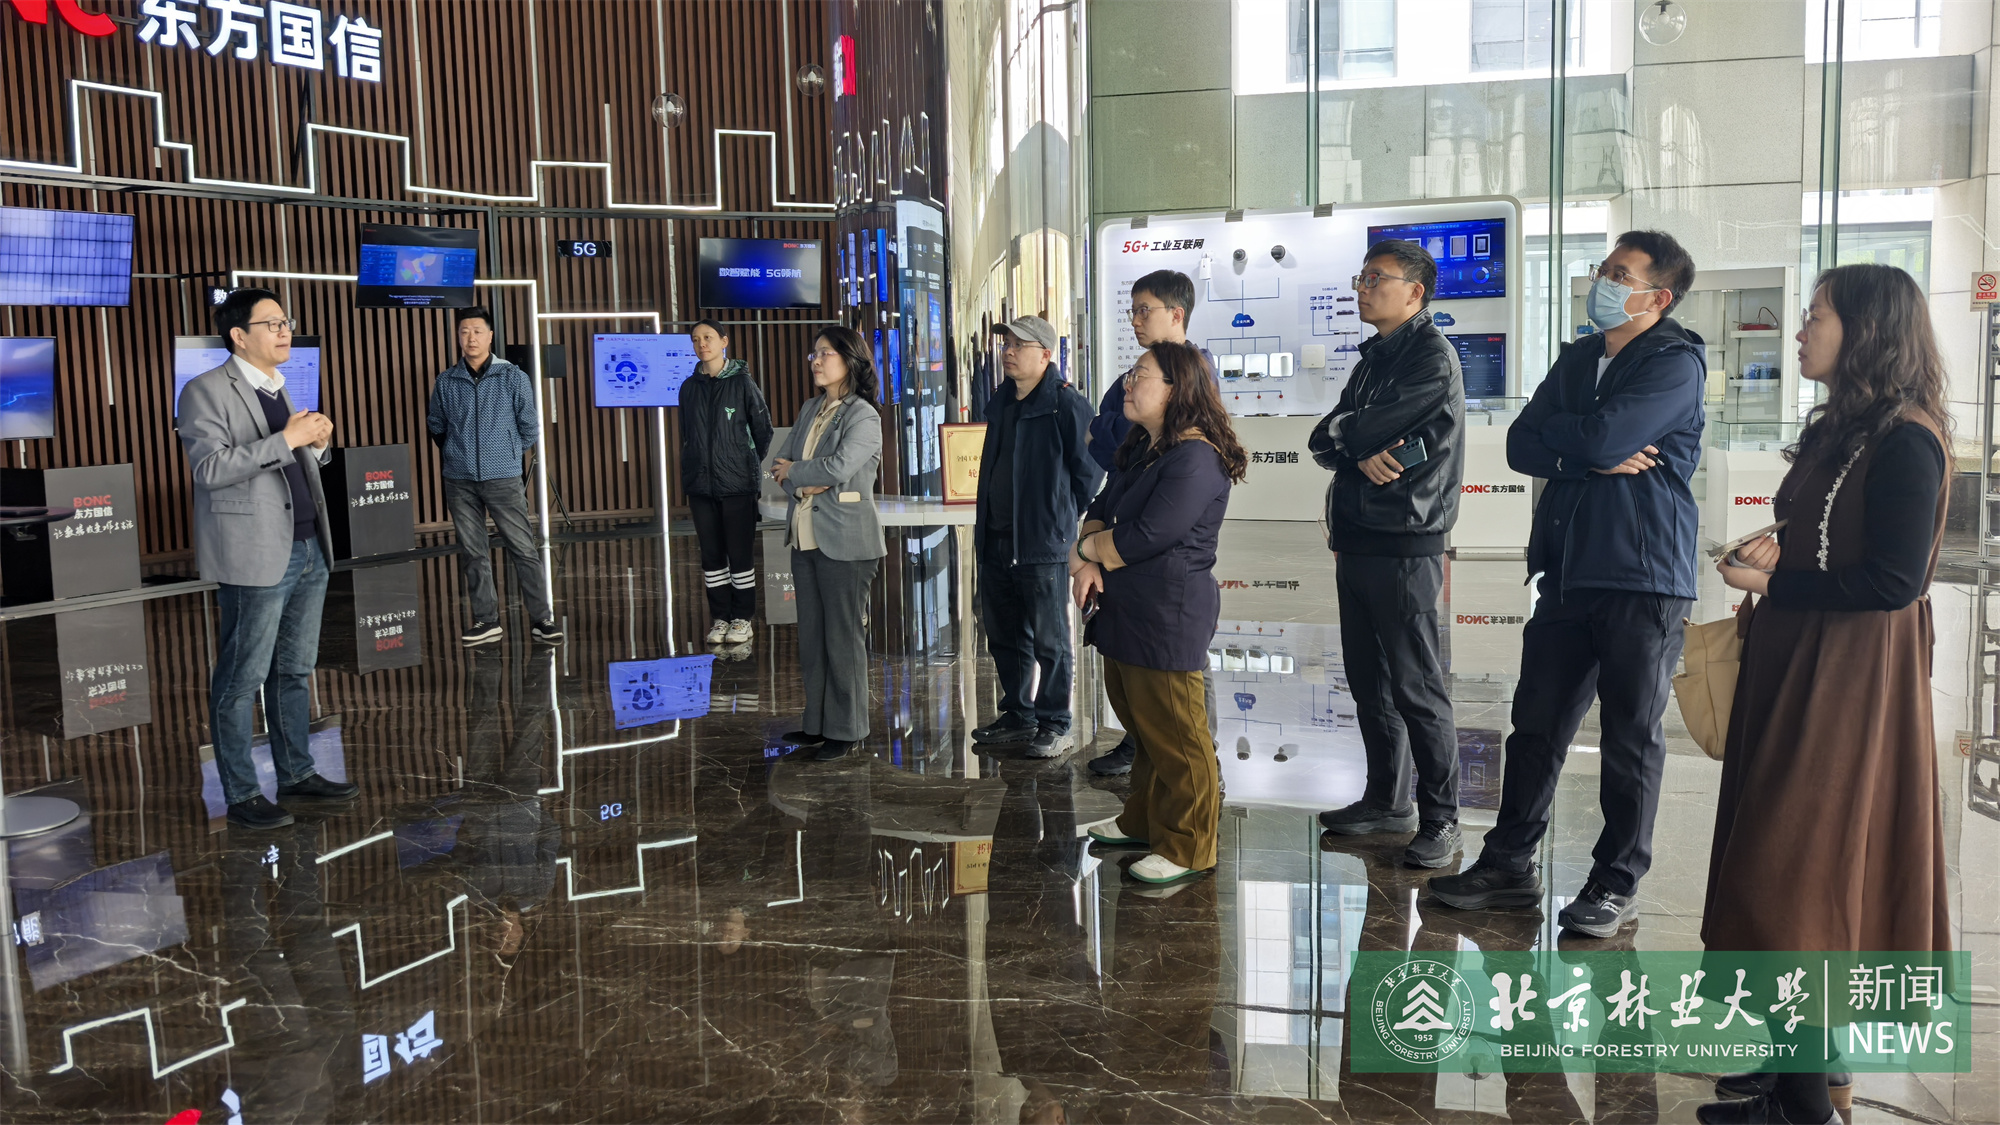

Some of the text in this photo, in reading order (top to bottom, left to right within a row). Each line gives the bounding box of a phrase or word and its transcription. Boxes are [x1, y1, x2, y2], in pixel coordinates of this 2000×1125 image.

[138, 0, 382, 82] 东方国信
[573, 242, 597, 256] 5G
[1122, 239, 1204, 253] 5G+ 工业互联网
[719, 267, 802, 278] 数智赋能 5G领航
[1251, 451, 1299, 463] 东方国信
[365, 470, 394, 481] BONC
[365, 480, 394, 490] 东方国信
[1491, 485, 1525, 493] 东方国信
[73, 495, 112, 508] BONC
[1735, 496, 1770, 505] BONC
[74, 506, 113, 519] 东方国信
